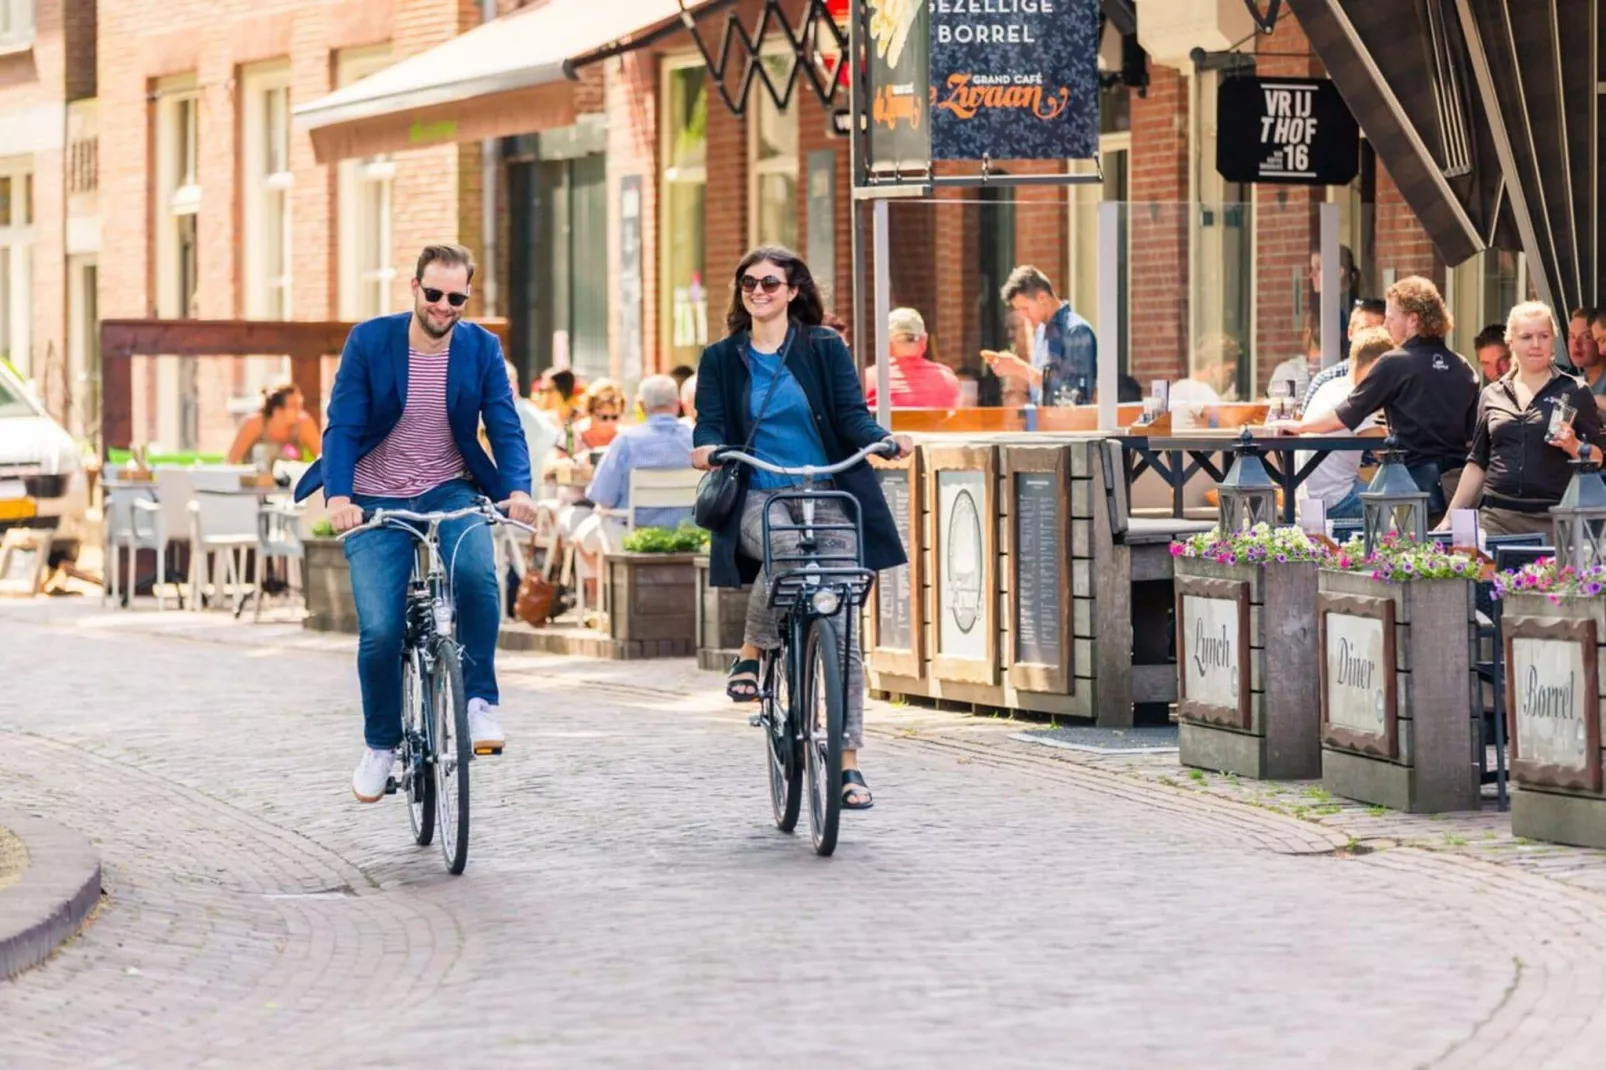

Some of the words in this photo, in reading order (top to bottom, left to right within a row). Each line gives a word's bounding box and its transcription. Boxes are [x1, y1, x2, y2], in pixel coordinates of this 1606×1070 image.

[938, 24, 1035, 43] BORREL
[972, 75, 1010, 84] GRAND
[1014, 72, 1042, 84] CAFÉ
[938, 72, 1069, 120] Zwaan
[1264, 89, 1312, 117] VRIJ
[1260, 116, 1318, 144] THOF
[1283, 144, 1309, 171] 16
[1193, 616, 1230, 678] Lunch
[1337, 636, 1375, 690] Diner
[1522, 664, 1575, 720] Borrel
